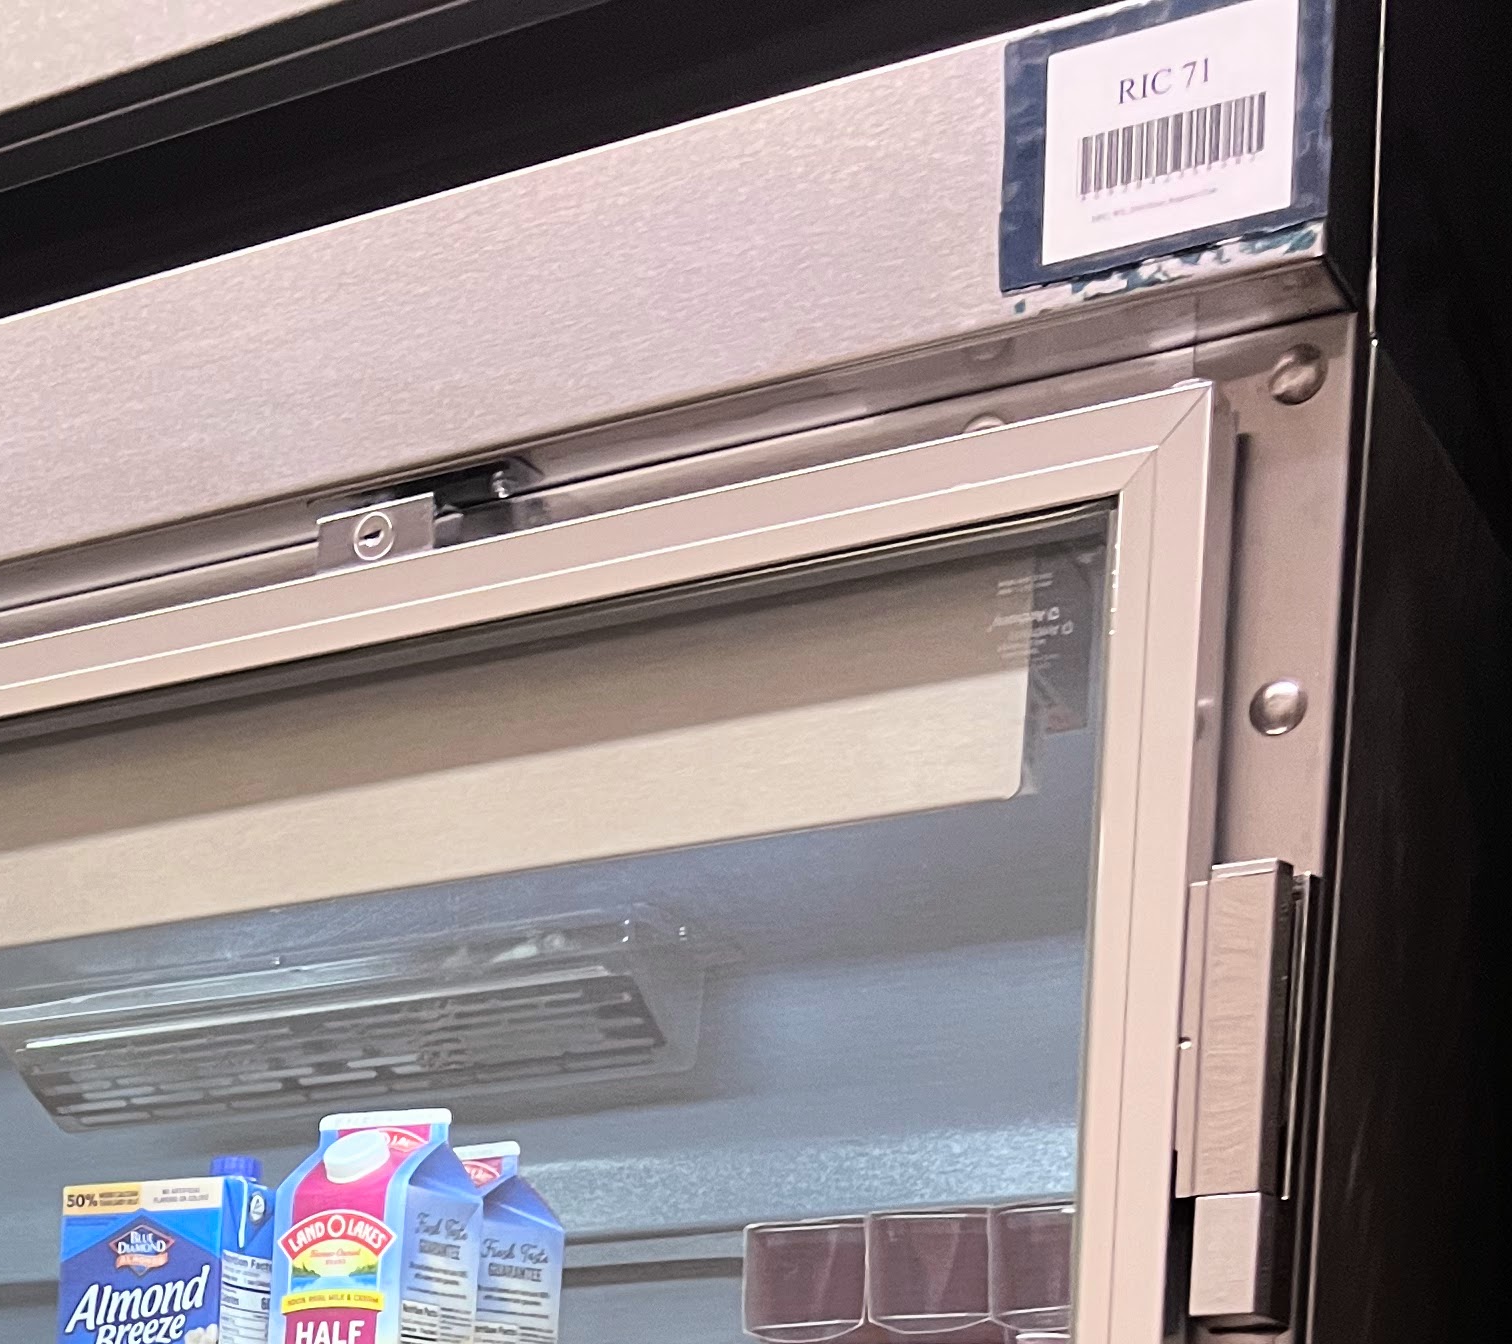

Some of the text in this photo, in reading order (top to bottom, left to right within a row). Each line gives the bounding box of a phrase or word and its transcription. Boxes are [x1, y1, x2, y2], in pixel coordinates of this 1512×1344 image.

[1119, 58, 1209, 104] RIC 71
[66, 1193, 98, 1208] 50%
[288, 1214, 386, 1253] LAND O LAKES
[64, 1264, 210, 1334] Almond
